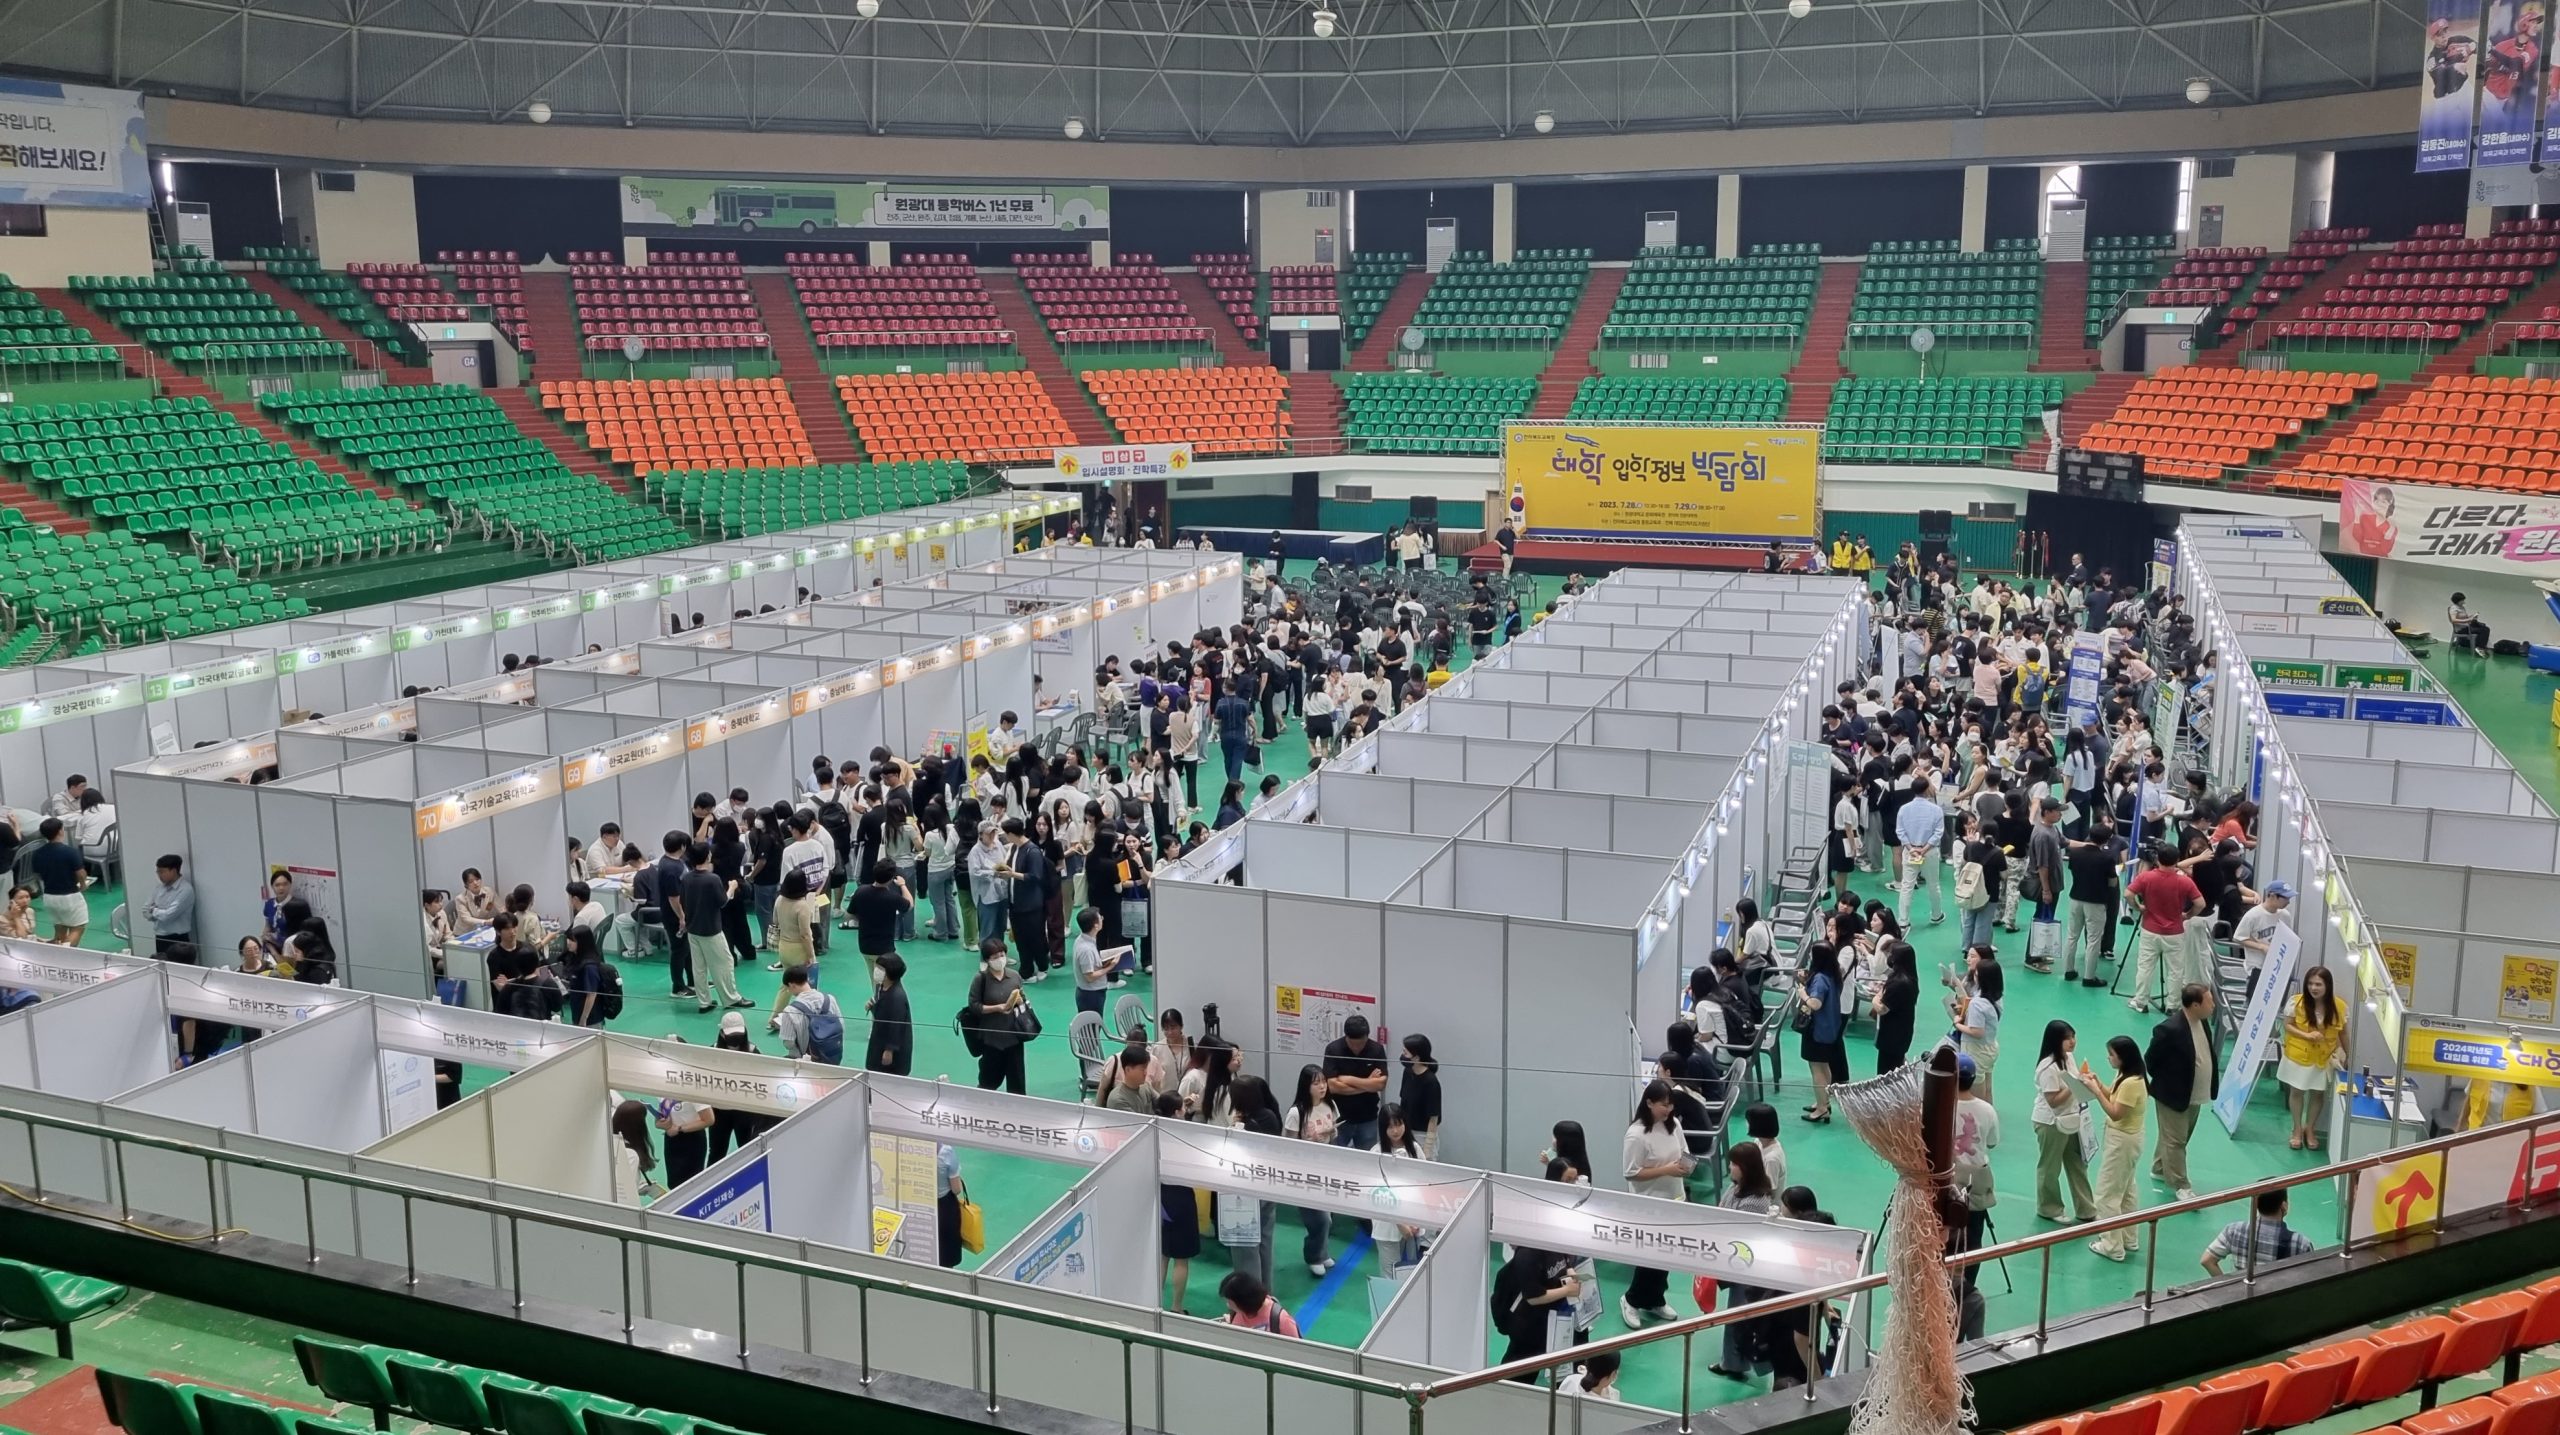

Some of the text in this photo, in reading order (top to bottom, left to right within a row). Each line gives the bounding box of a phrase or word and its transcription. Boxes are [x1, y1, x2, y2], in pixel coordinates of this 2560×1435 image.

[895, 198, 1034, 212] 원광대 통학버스 1년 무료
[1081, 463, 1167, 478] 입시설명회 진학특강
[1551, 448, 1767, 493] 대학 입학정보 박람회
[2423, 503, 2529, 529] 다르다.
[2406, 532, 2510, 557] 그래서
[396, 625, 464, 647] 11 가천대학교
[280, 645, 363, 671] 12 가톨릭대학교
[149, 683, 164, 698] 13
[52, 695, 113, 715] 경상국립대학교
[690, 712, 761, 745] 68 충북대학교
[567, 744, 659, 784] 69 한국교원대학교
[421, 783, 537, 831] 70 한국기술교육대학교
[2442, 1042, 2494, 1056] 2024학년도
[2443, 1052, 2491, 1065] 대입을 위한
[713, 1187, 735, 1208] 인재상
[698, 1201, 712, 1218] KIT
[740, 1200, 761, 1223] ICON
